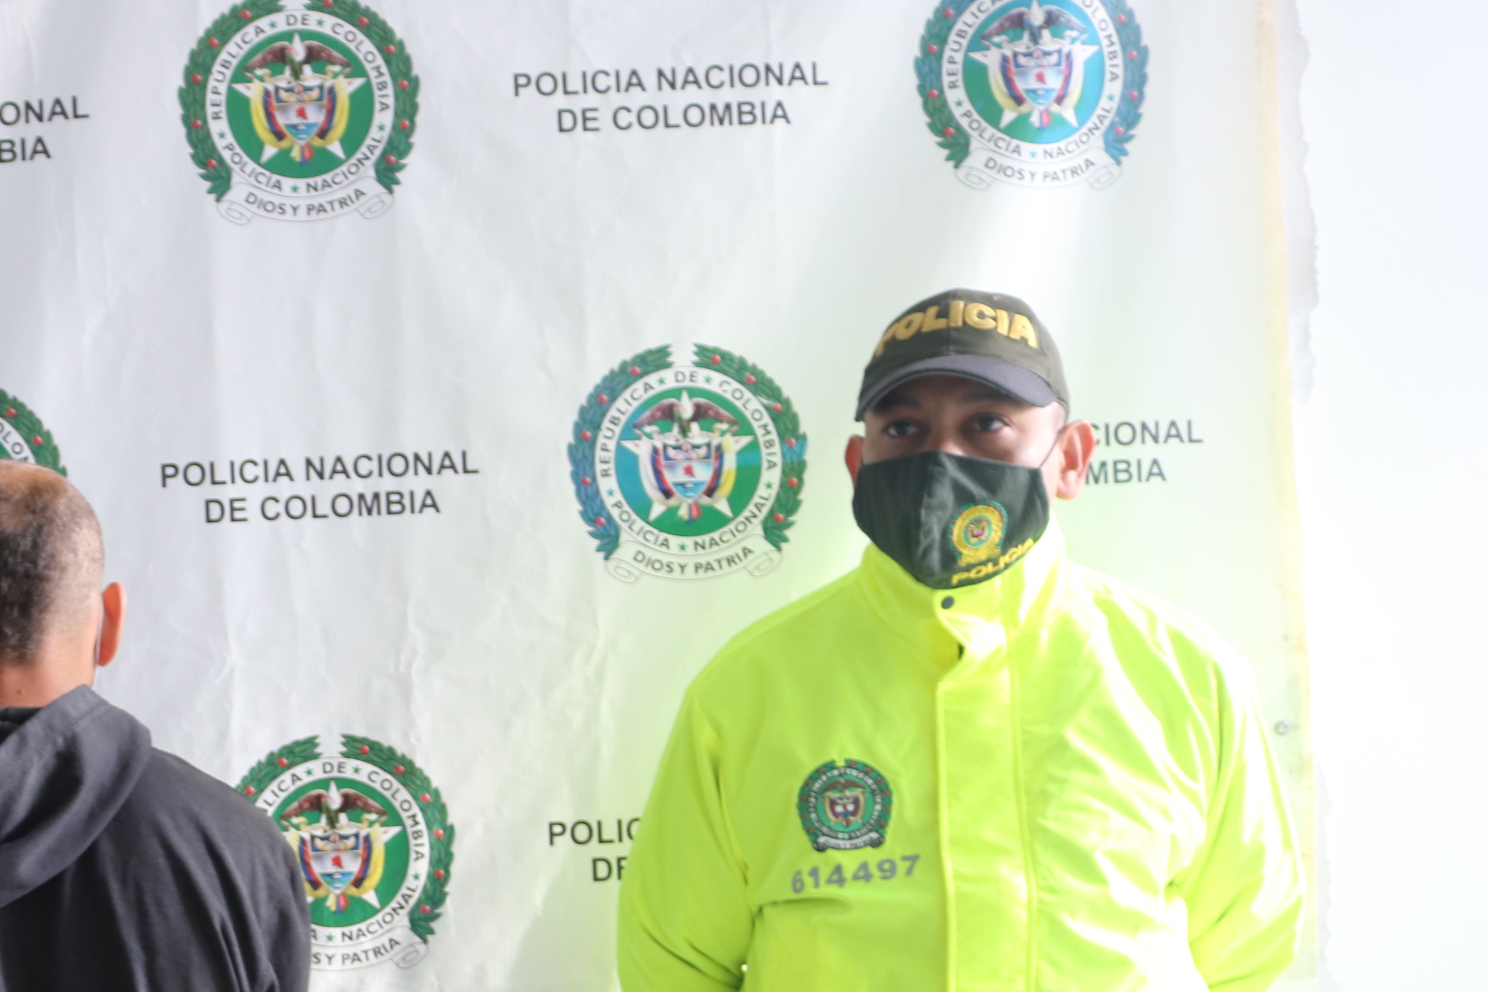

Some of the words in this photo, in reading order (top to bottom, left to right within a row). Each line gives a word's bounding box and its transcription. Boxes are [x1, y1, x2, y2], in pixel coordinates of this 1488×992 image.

[286, 14, 311, 26] DE
[332, 22, 391, 113] COLOMBIA
[513, 68, 647, 98] POLICIA
[656, 61, 829, 92] NACIONAL
[557, 107, 601, 134] DE
[611, 100, 792, 131] COLOMBIA
[1042, 105, 1114, 159] NACIONAL
[306, 134, 385, 194] NACIONAL
[1043, 157, 1095, 183] PATRIA
[306, 187, 366, 216] PATRIA
[674, 371, 699, 383] DE
[719, 379, 777, 470] COLOMBIA
[160, 457, 295, 489] POLICIA
[304, 449, 480, 482] NACIONAL
[1084, 457, 1168, 485] MBIA
[204, 496, 249, 524] DE
[259, 488, 441, 522] COLOMBIA
[694, 493, 773, 551] NACIONAL
[695, 544, 754, 574] PATRIA
[322, 762, 347, 774] DE
[368, 770, 426, 862] COLOMBIA
[548, 817, 642, 847] POLIC
[791, 854, 921, 894] 614497
[341, 884, 418, 942] NACIONAL
[341, 937, 401, 965] PATRIA
